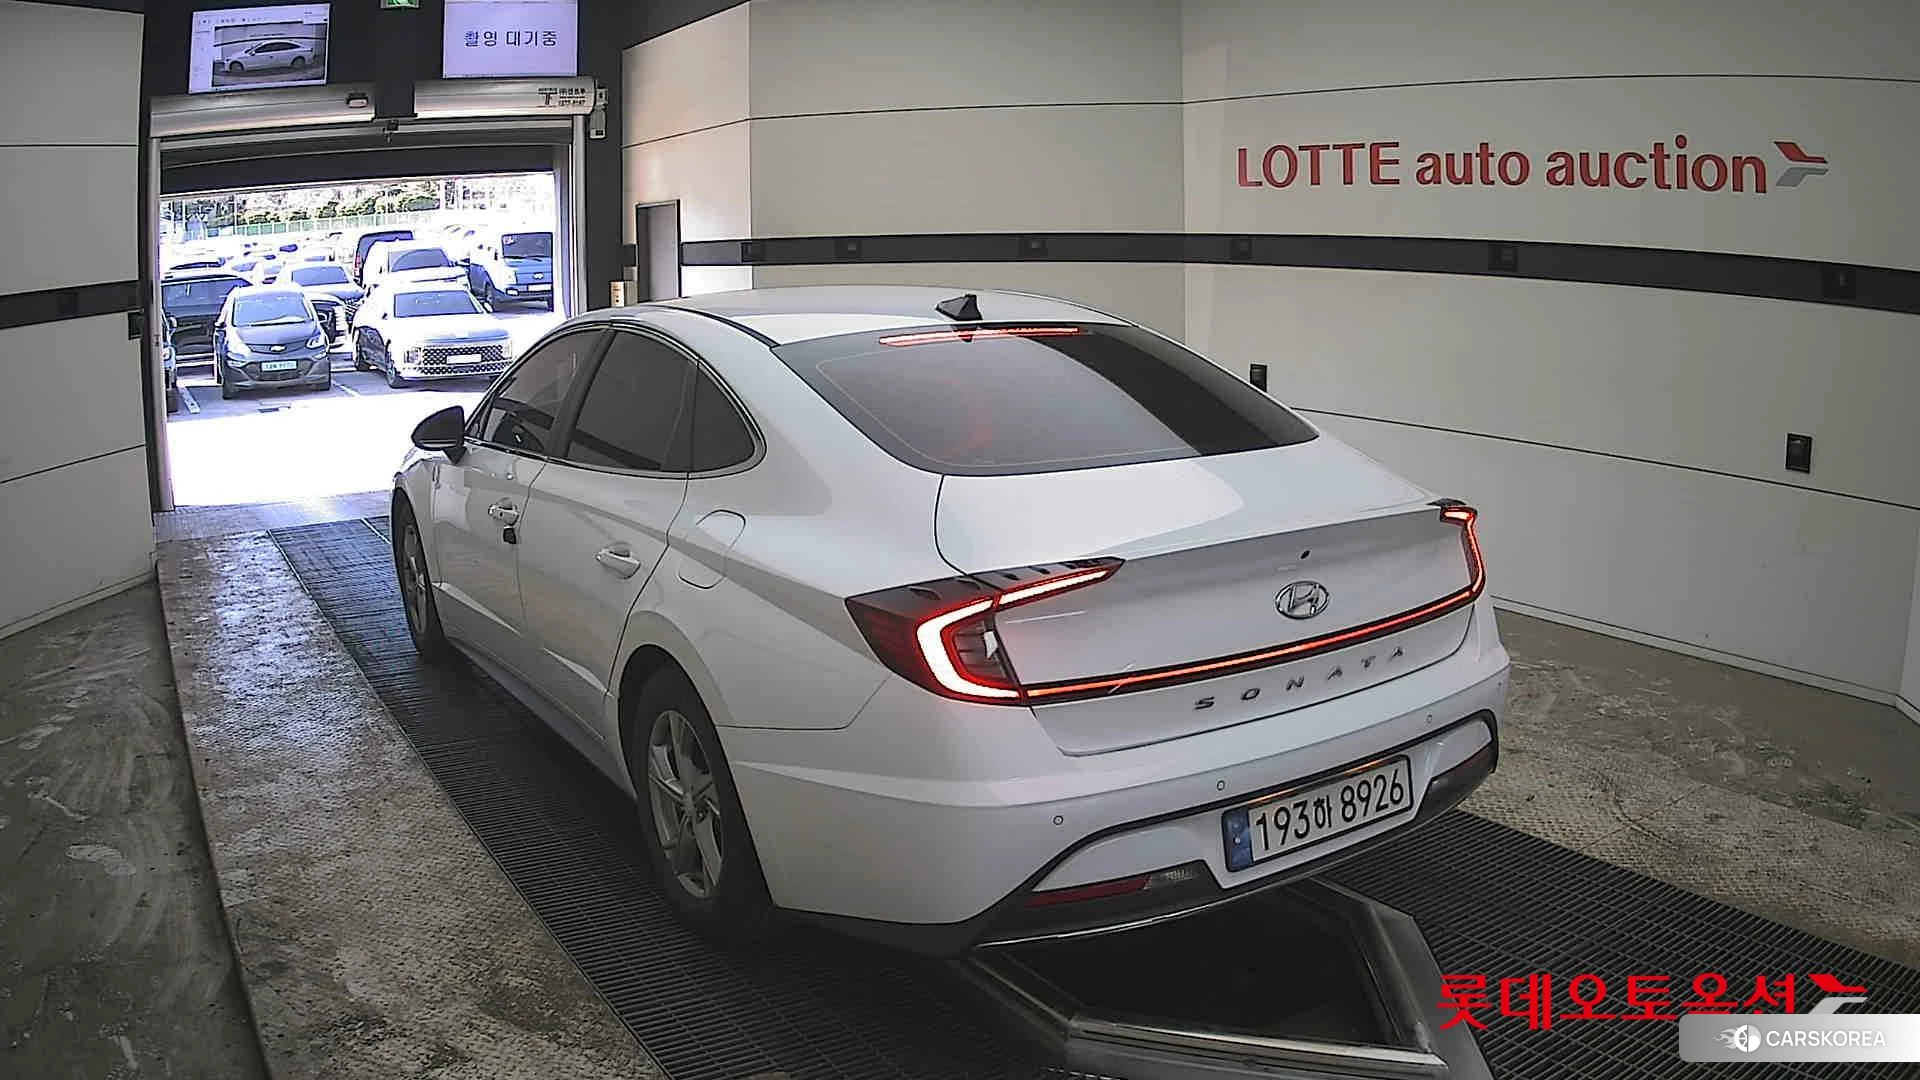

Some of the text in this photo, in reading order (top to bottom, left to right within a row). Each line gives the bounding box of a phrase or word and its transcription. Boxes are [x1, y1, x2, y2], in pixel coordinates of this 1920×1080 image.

[506, 30, 558, 47] 대기중
[1236, 134, 1767, 194] LOTTE auto auction
[1195, 647, 1403, 710] SONATA
[1340, 768, 1404, 823] 8926
